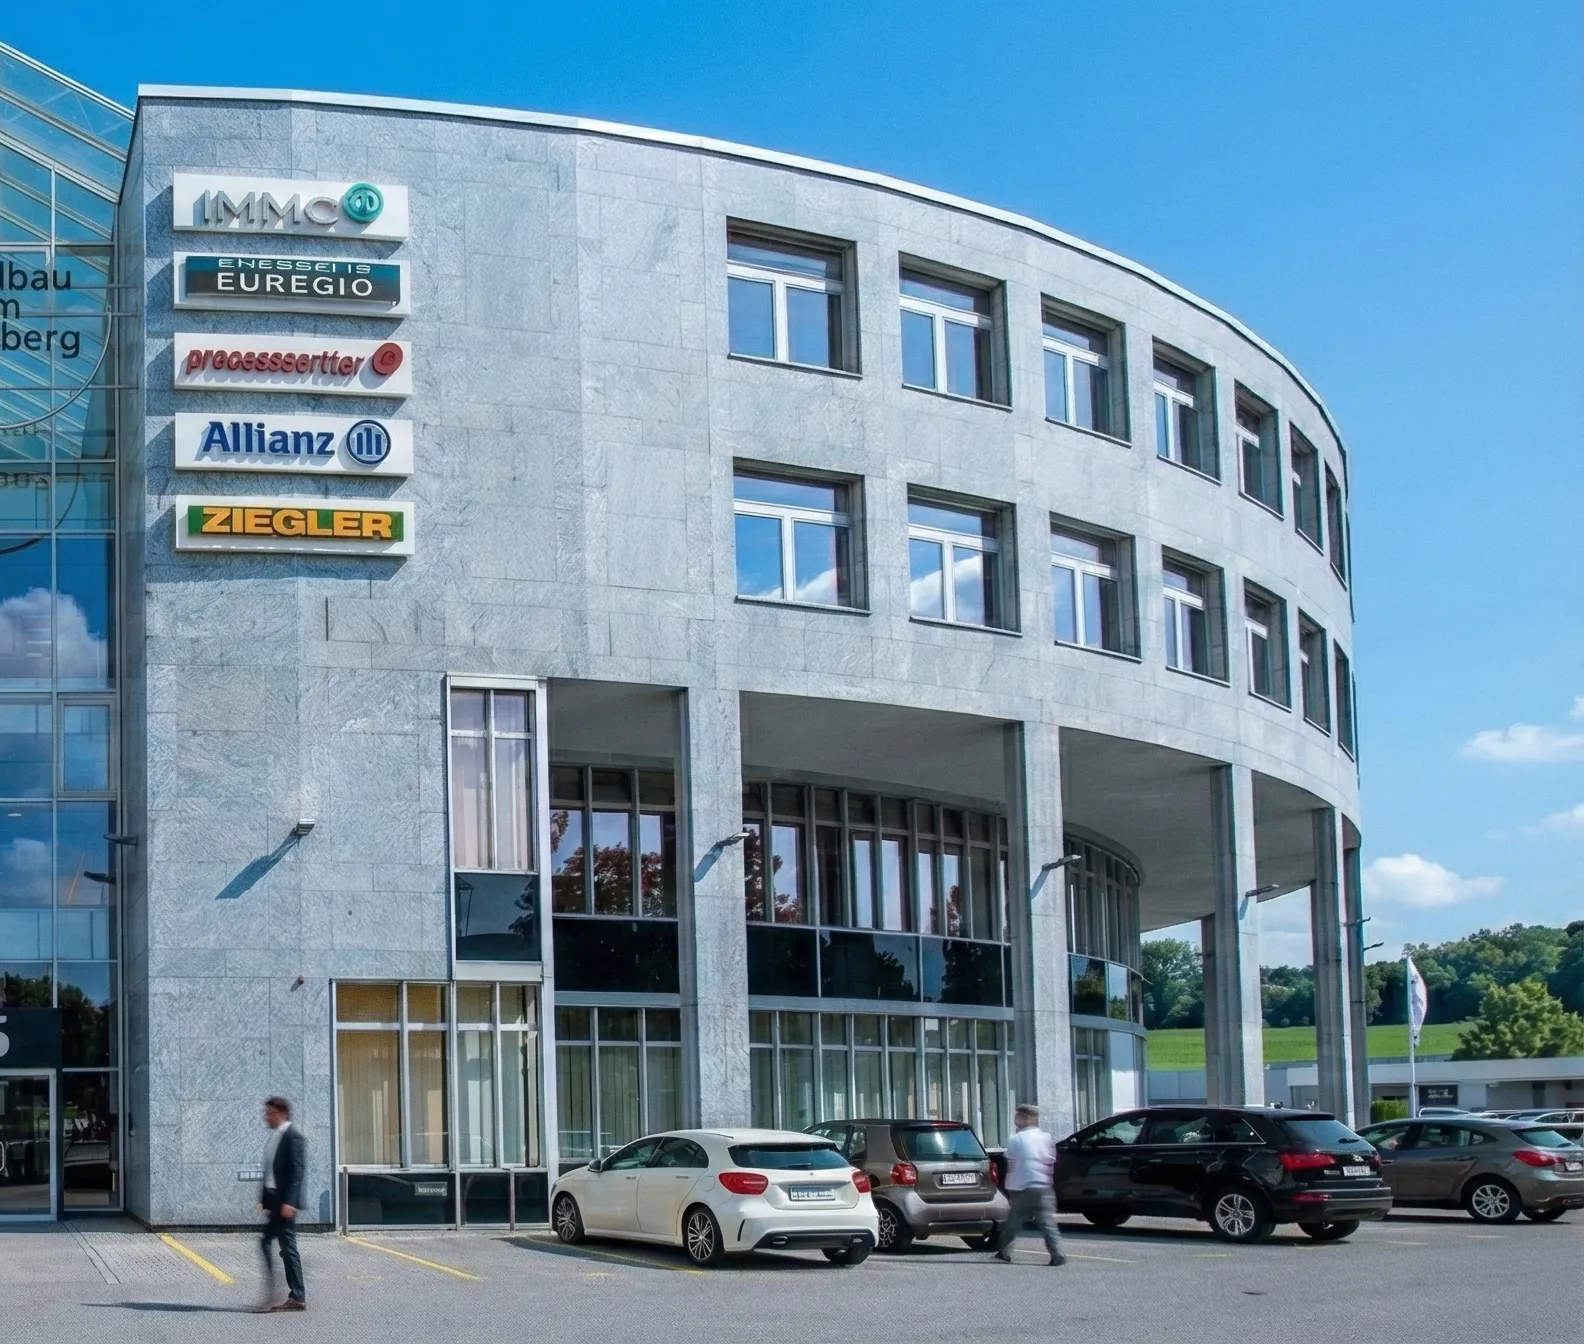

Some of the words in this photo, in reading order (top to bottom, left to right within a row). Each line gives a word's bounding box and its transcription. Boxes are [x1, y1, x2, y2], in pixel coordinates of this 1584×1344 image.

[217, 272, 373, 296] EUREGIO
[203, 421, 335, 455] Allianz
[202, 507, 392, 538] ZIEGLER
